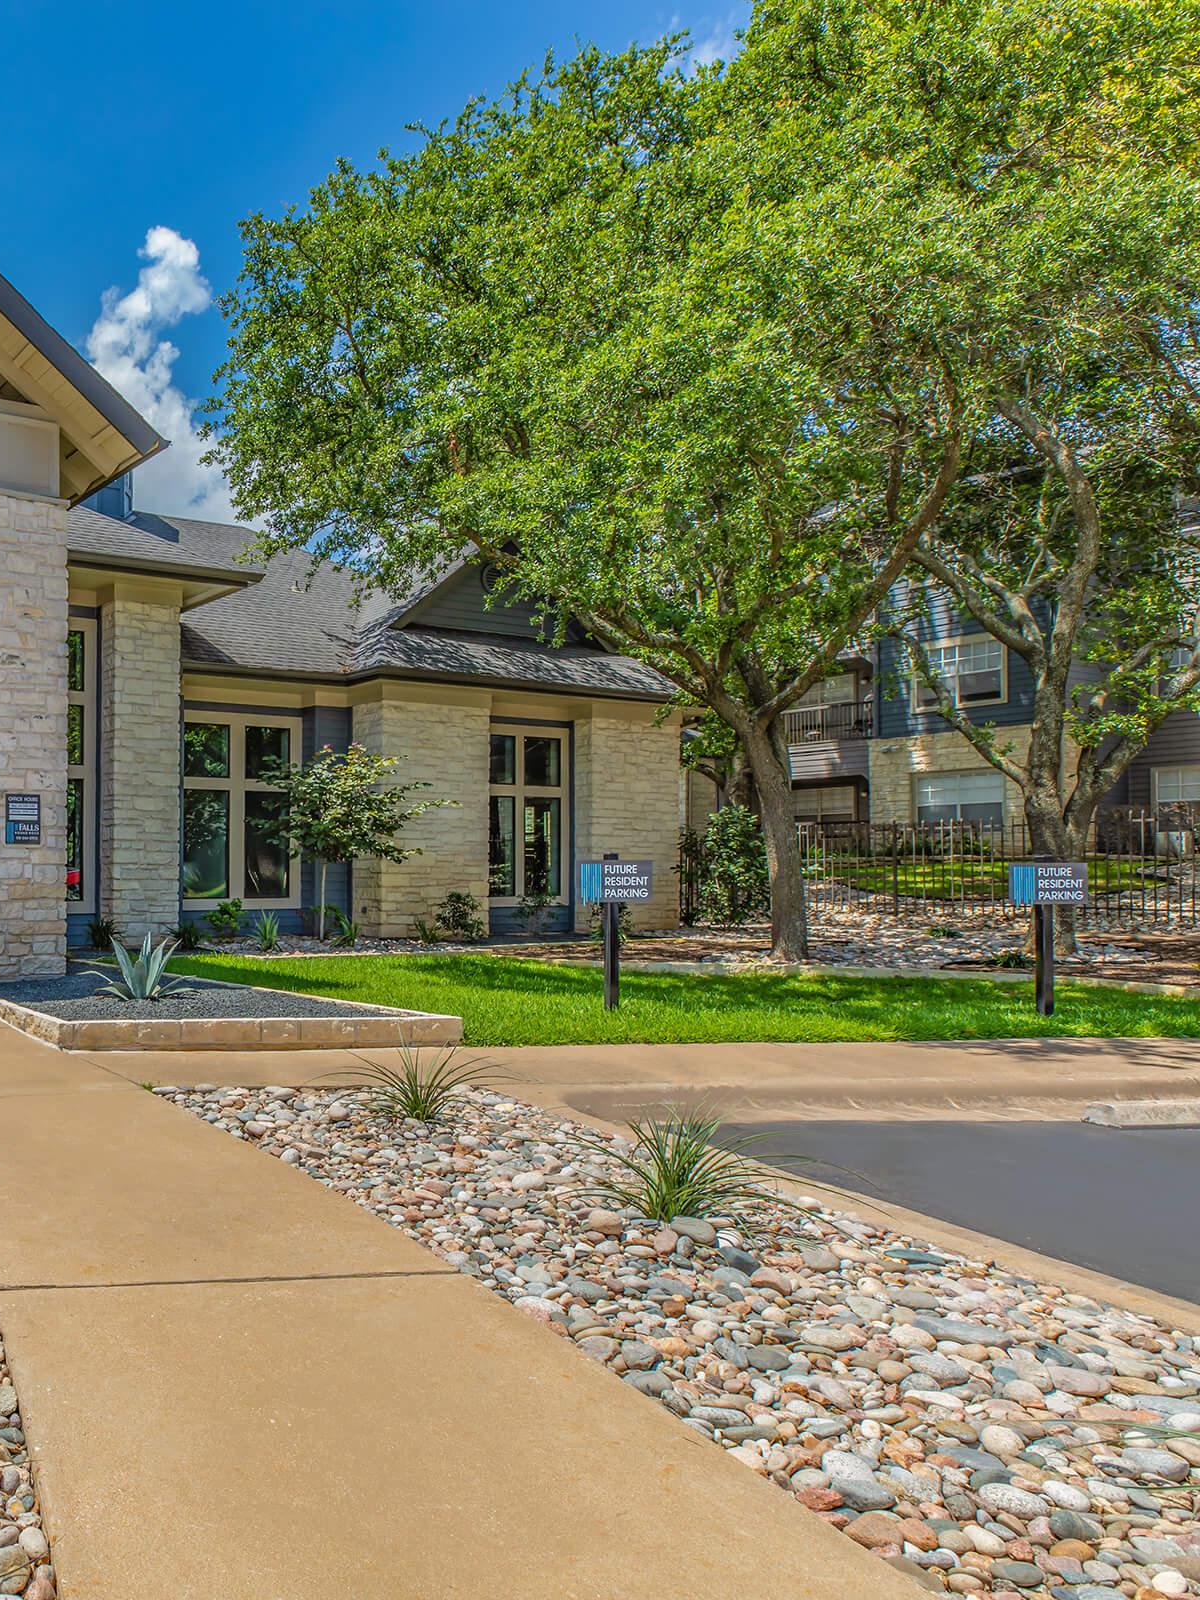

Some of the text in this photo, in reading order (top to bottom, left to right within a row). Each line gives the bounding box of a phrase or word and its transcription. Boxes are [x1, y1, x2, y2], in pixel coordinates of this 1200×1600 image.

[604, 864, 638, 874] FUTURE
[1038, 867, 1072, 877] FUTURE
[604, 876, 649, 886] RESIDENT
[1038, 879, 1083, 889] RESIDENT
[604, 888, 649, 898] PARKING
[1038, 890, 1084, 900] PARKING
